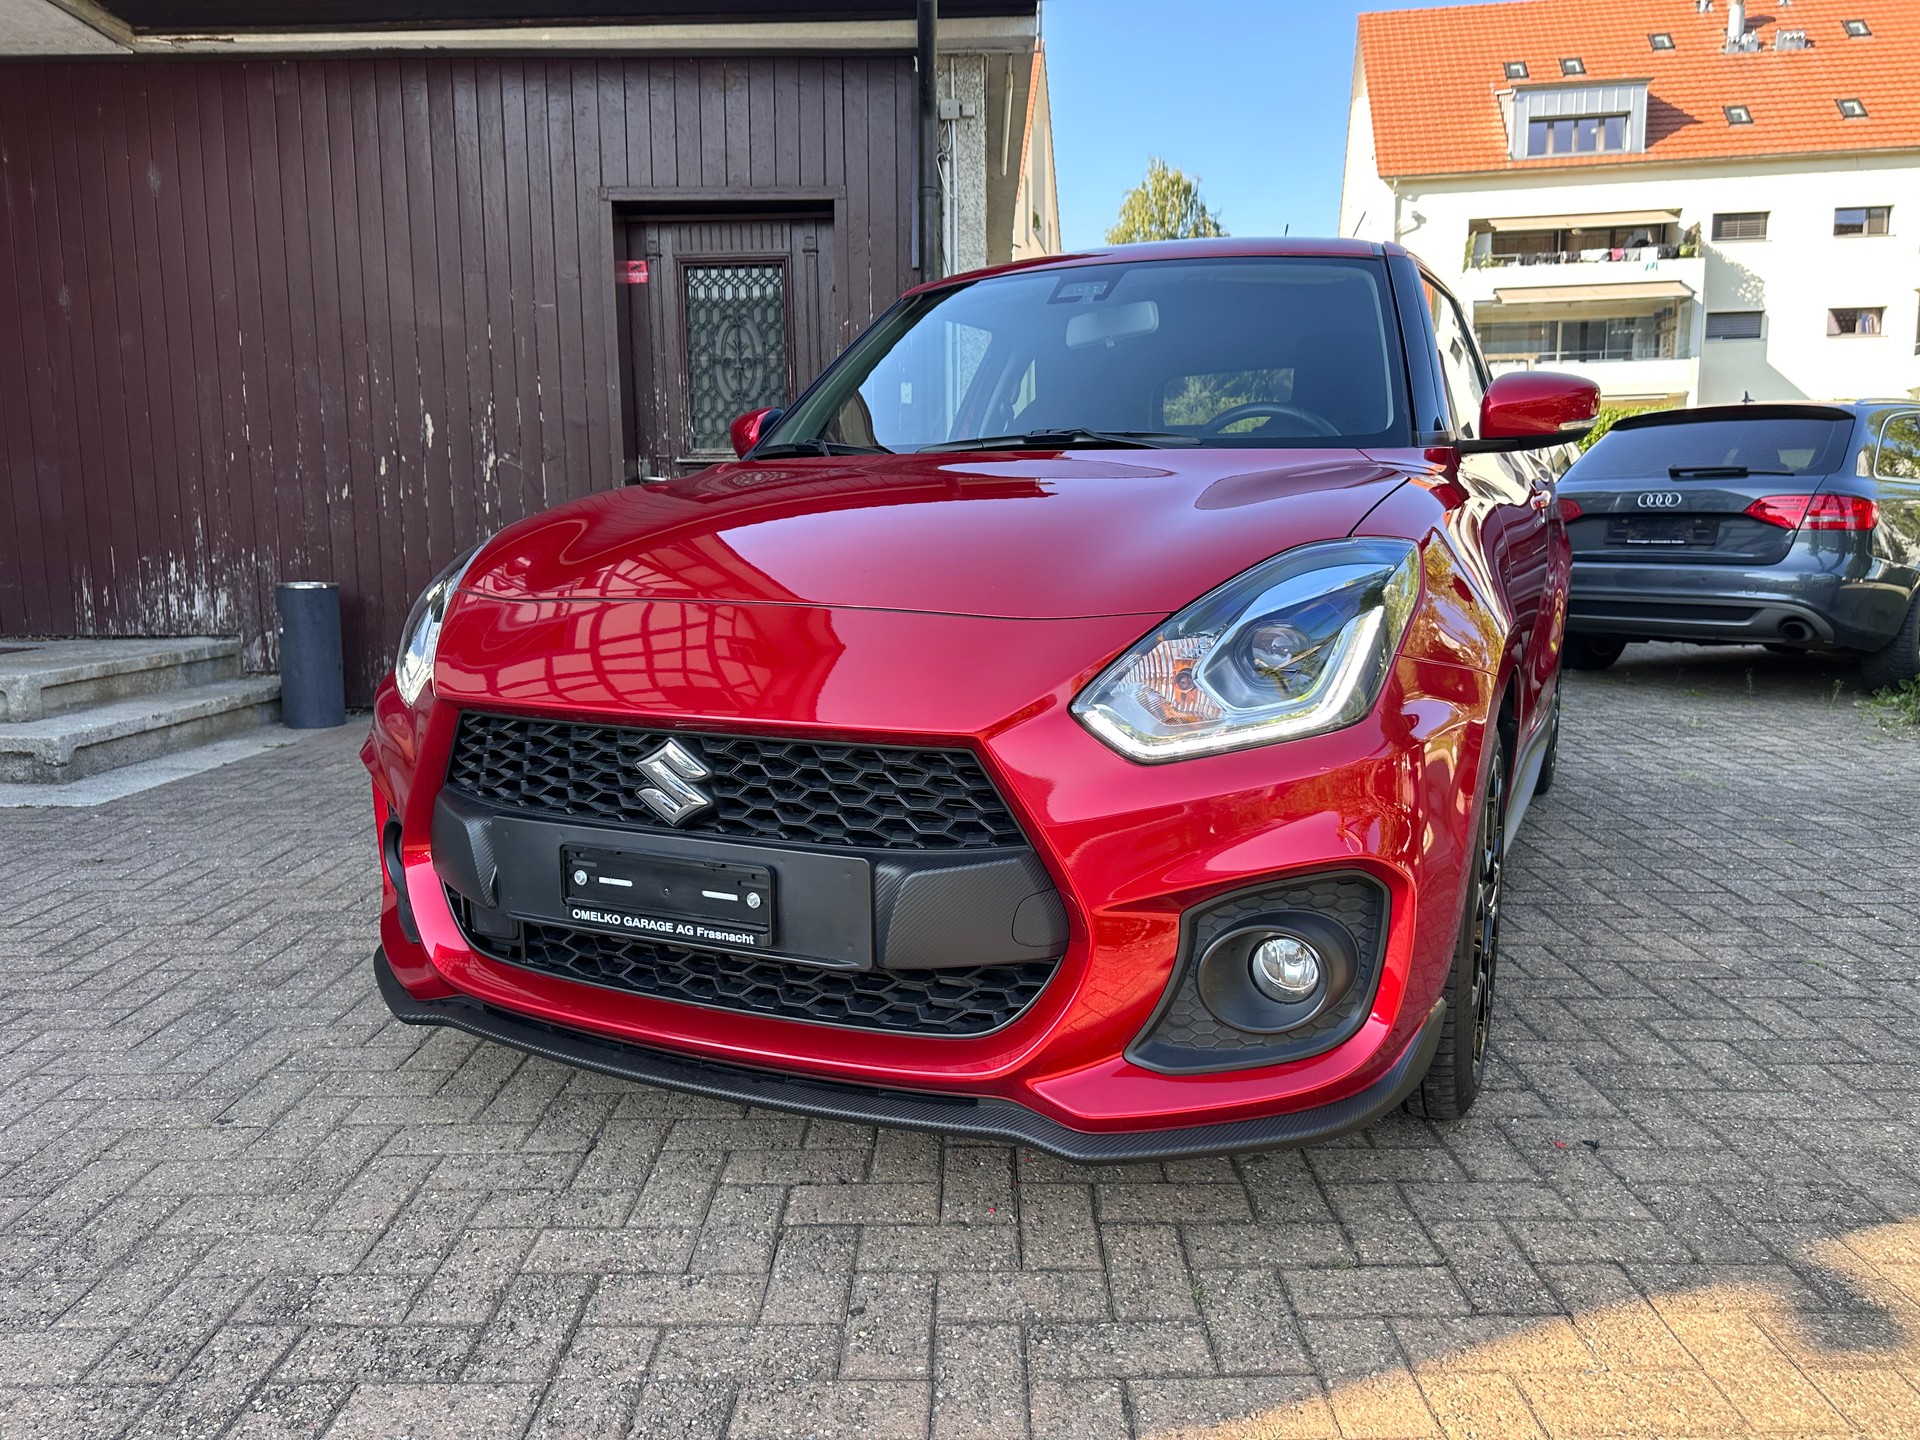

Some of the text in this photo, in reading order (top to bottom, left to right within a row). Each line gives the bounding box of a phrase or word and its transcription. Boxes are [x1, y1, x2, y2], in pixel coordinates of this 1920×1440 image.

[572, 908, 755, 945] OMELKO GARAGE AG Frasnacht
